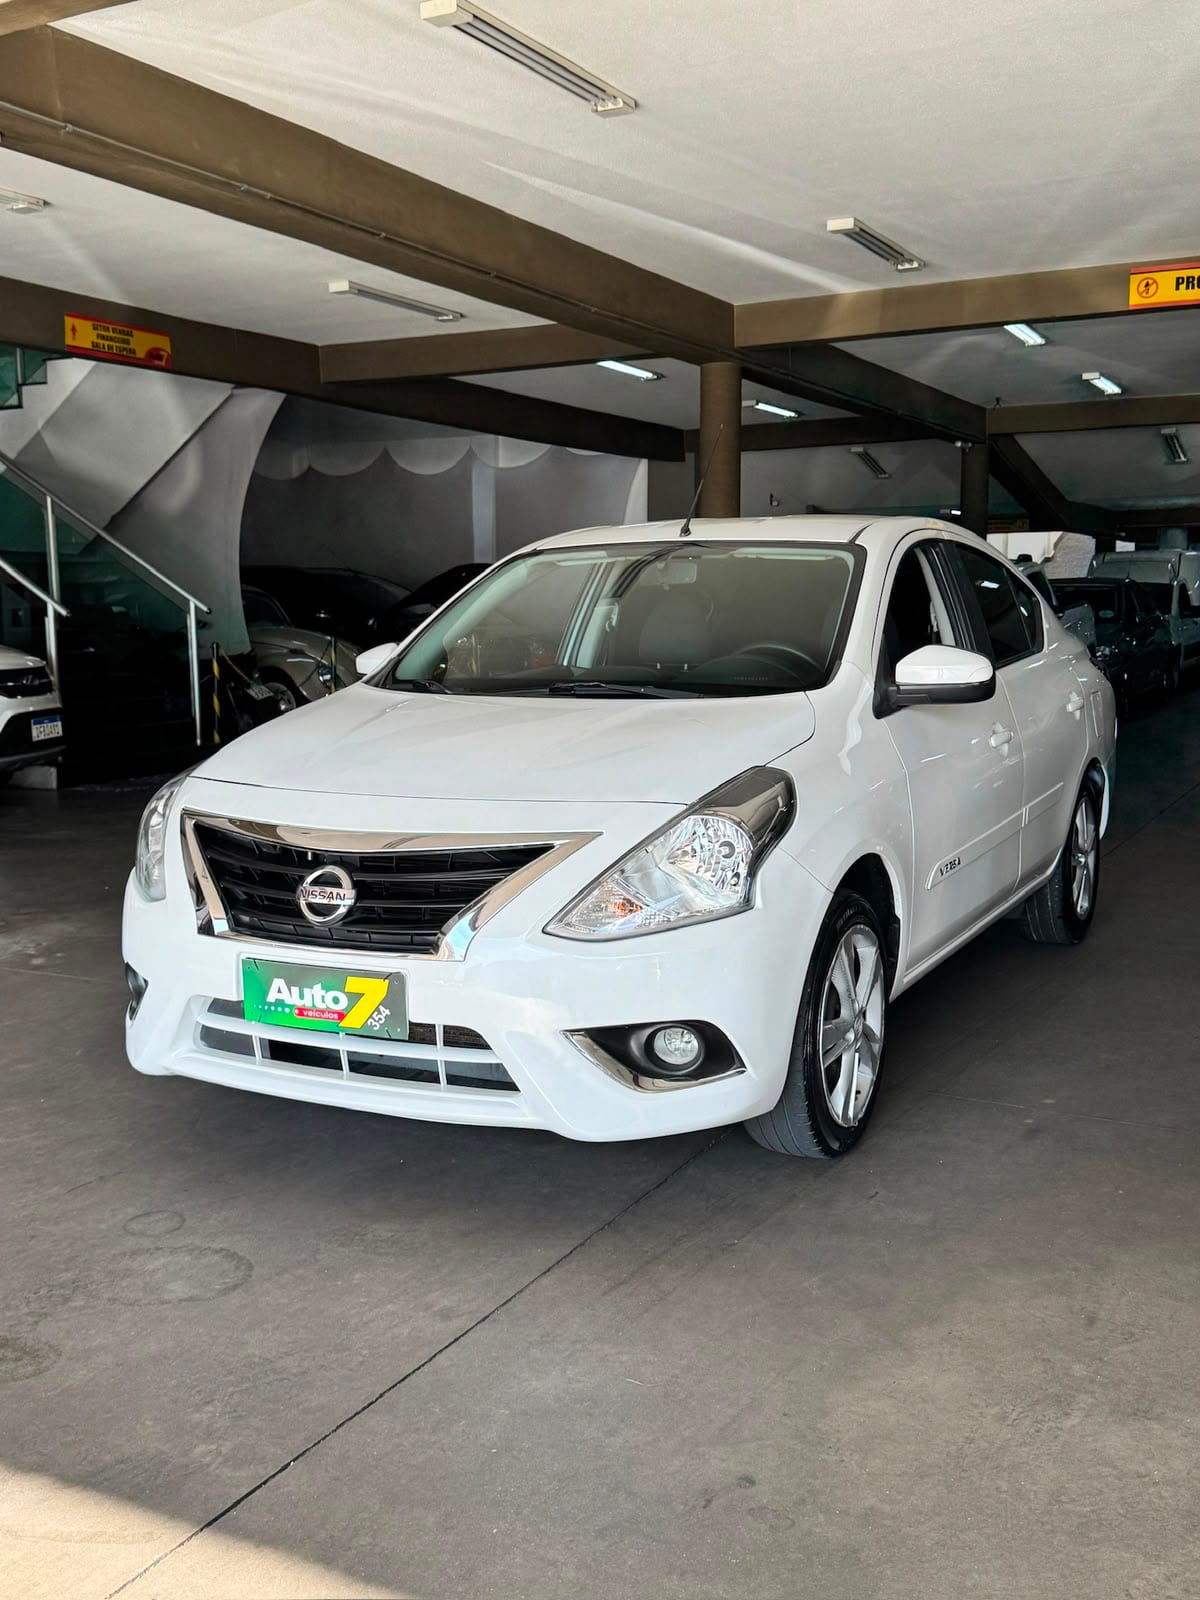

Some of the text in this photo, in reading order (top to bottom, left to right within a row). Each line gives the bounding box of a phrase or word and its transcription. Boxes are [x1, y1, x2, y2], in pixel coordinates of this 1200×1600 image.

[111, 327, 134, 337] VENDAS
[91, 341, 106, 350] SALA
[115, 346, 136, 356] ESPERA
[300, 887, 346, 902] NISSAN
[367, 1005, 391, 1031] 354
